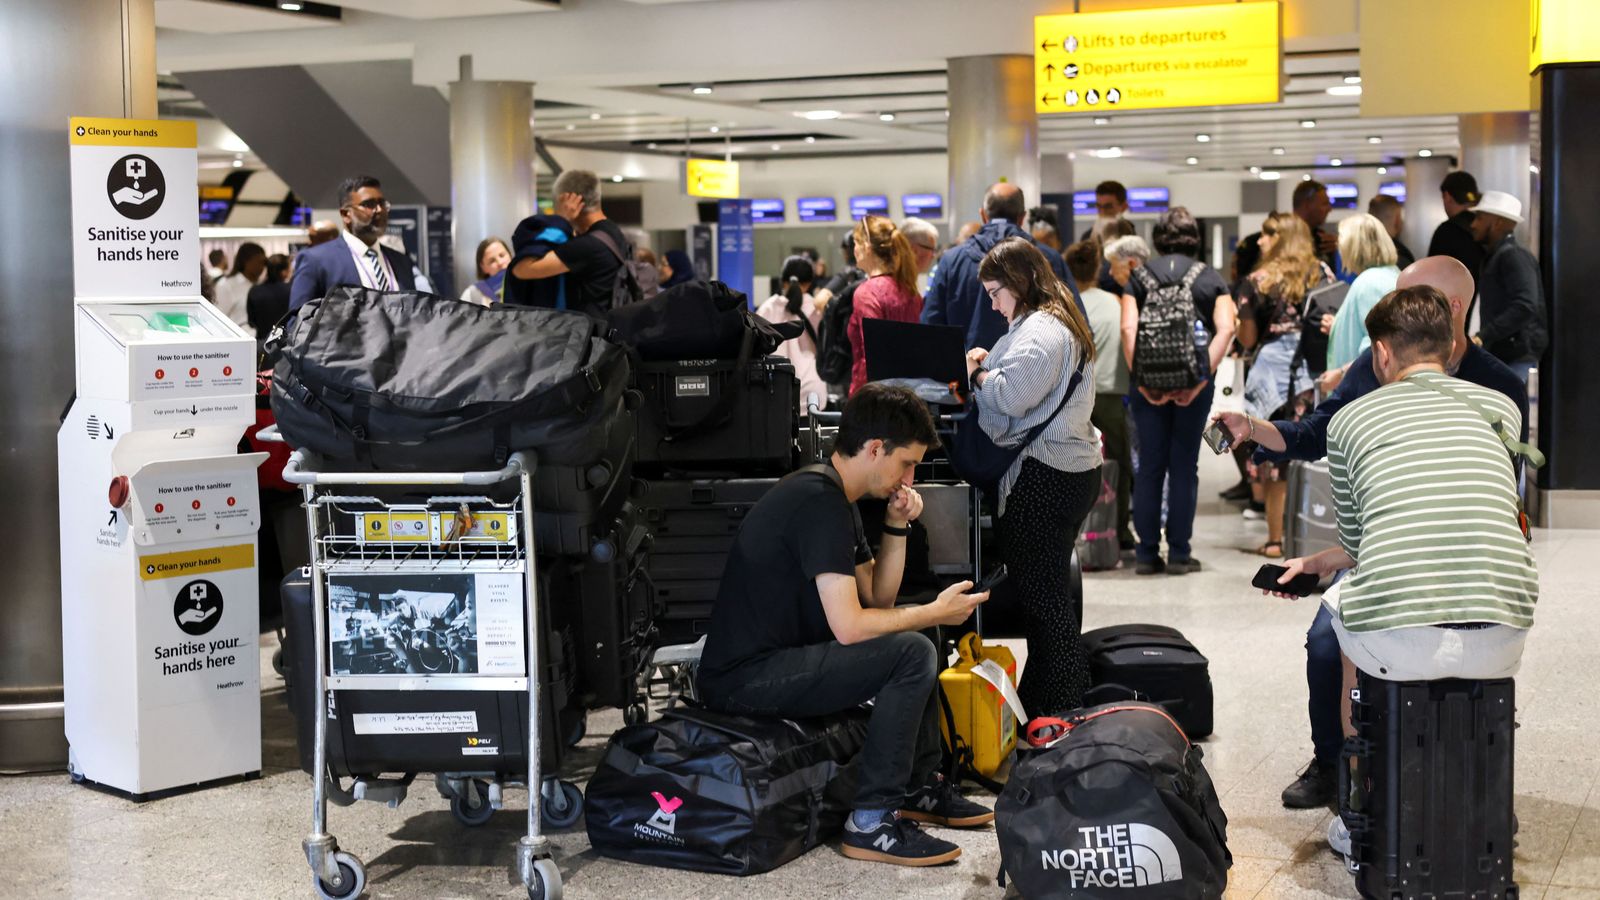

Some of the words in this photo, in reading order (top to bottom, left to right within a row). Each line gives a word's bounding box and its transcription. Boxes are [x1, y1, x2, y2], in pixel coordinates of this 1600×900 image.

[1083, 34, 1114, 49] Lifts
[1120, 35, 1136, 47] to
[1140, 29, 1226, 46] departures
[1083, 59, 1170, 78] Departures
[1173, 60, 1191, 70] via
[1194, 58, 1249, 70] escalator
[1127, 88, 1165, 99] Toilets
[88, 127, 111, 136] Clean
[113, 129, 131, 138] your
[134, 129, 158, 137] hands
[88, 227, 146, 241] Sanitise
[150, 230, 184, 244] your
[98, 247, 143, 261] hands
[146, 247, 179, 261] here
[161, 280, 193, 288] Heathrow
[158, 486, 173, 494] How
[174, 485, 182, 493] to
[195, 483, 205, 491] the
[206, 482, 231, 490] sanitiser
[157, 560, 178, 572] Clean
[179, 559, 198, 570] your
[198, 556, 221, 567] hands
[154, 642, 206, 660] Sanitise
[209, 637, 239, 655] your
[163, 658, 203, 676] hands
[206, 655, 235, 669] here
[216, 681, 244, 690] Heathrow
[634, 822, 685, 844] MOUNTAIN
[1078, 824, 1129, 848] THE
[1041, 846, 1132, 870] NORTH
[1069, 868, 1135, 889] FACE
